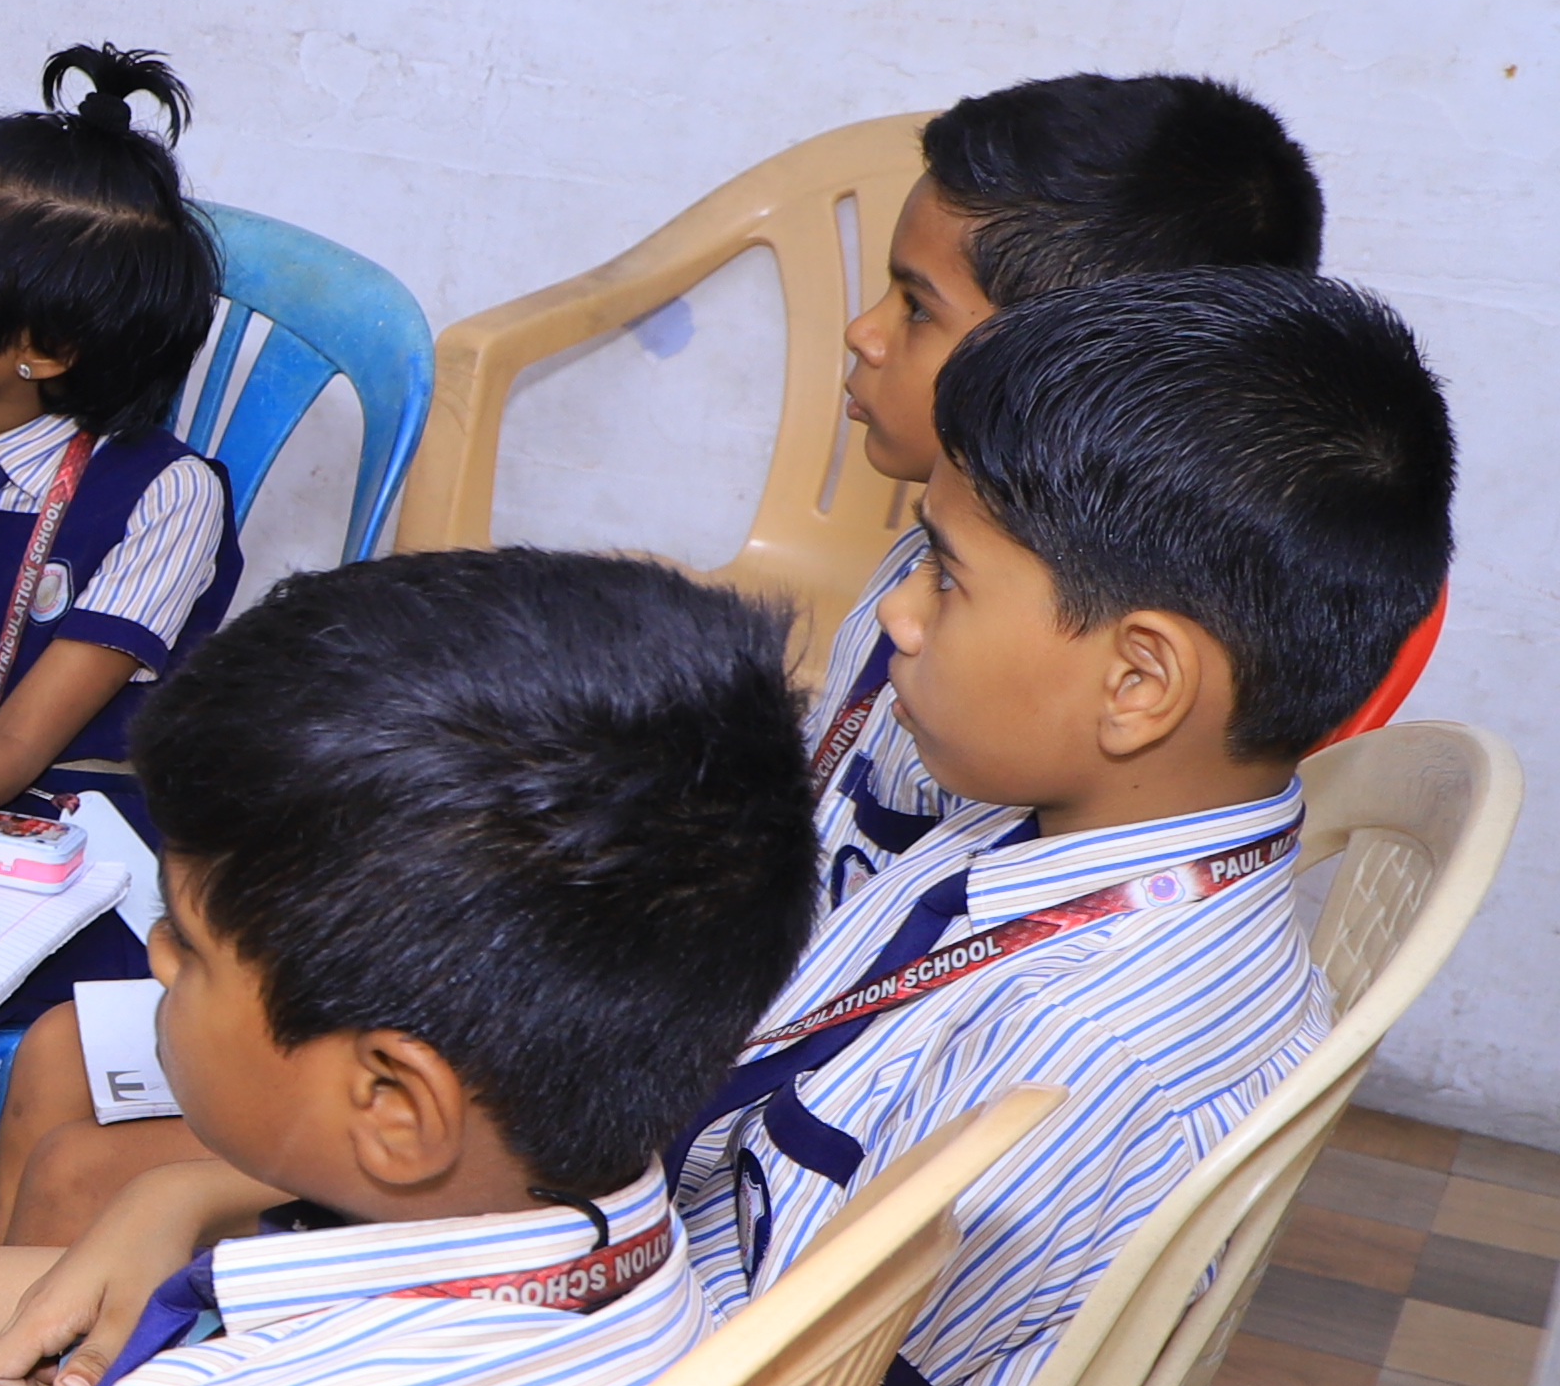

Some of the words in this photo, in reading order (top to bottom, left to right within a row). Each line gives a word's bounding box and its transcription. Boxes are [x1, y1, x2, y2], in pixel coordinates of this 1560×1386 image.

[29, 499, 65, 565] SCHOOL
[1210, 848, 1266, 883] PAUL
[904, 935, 1004, 989] SCHOOL
